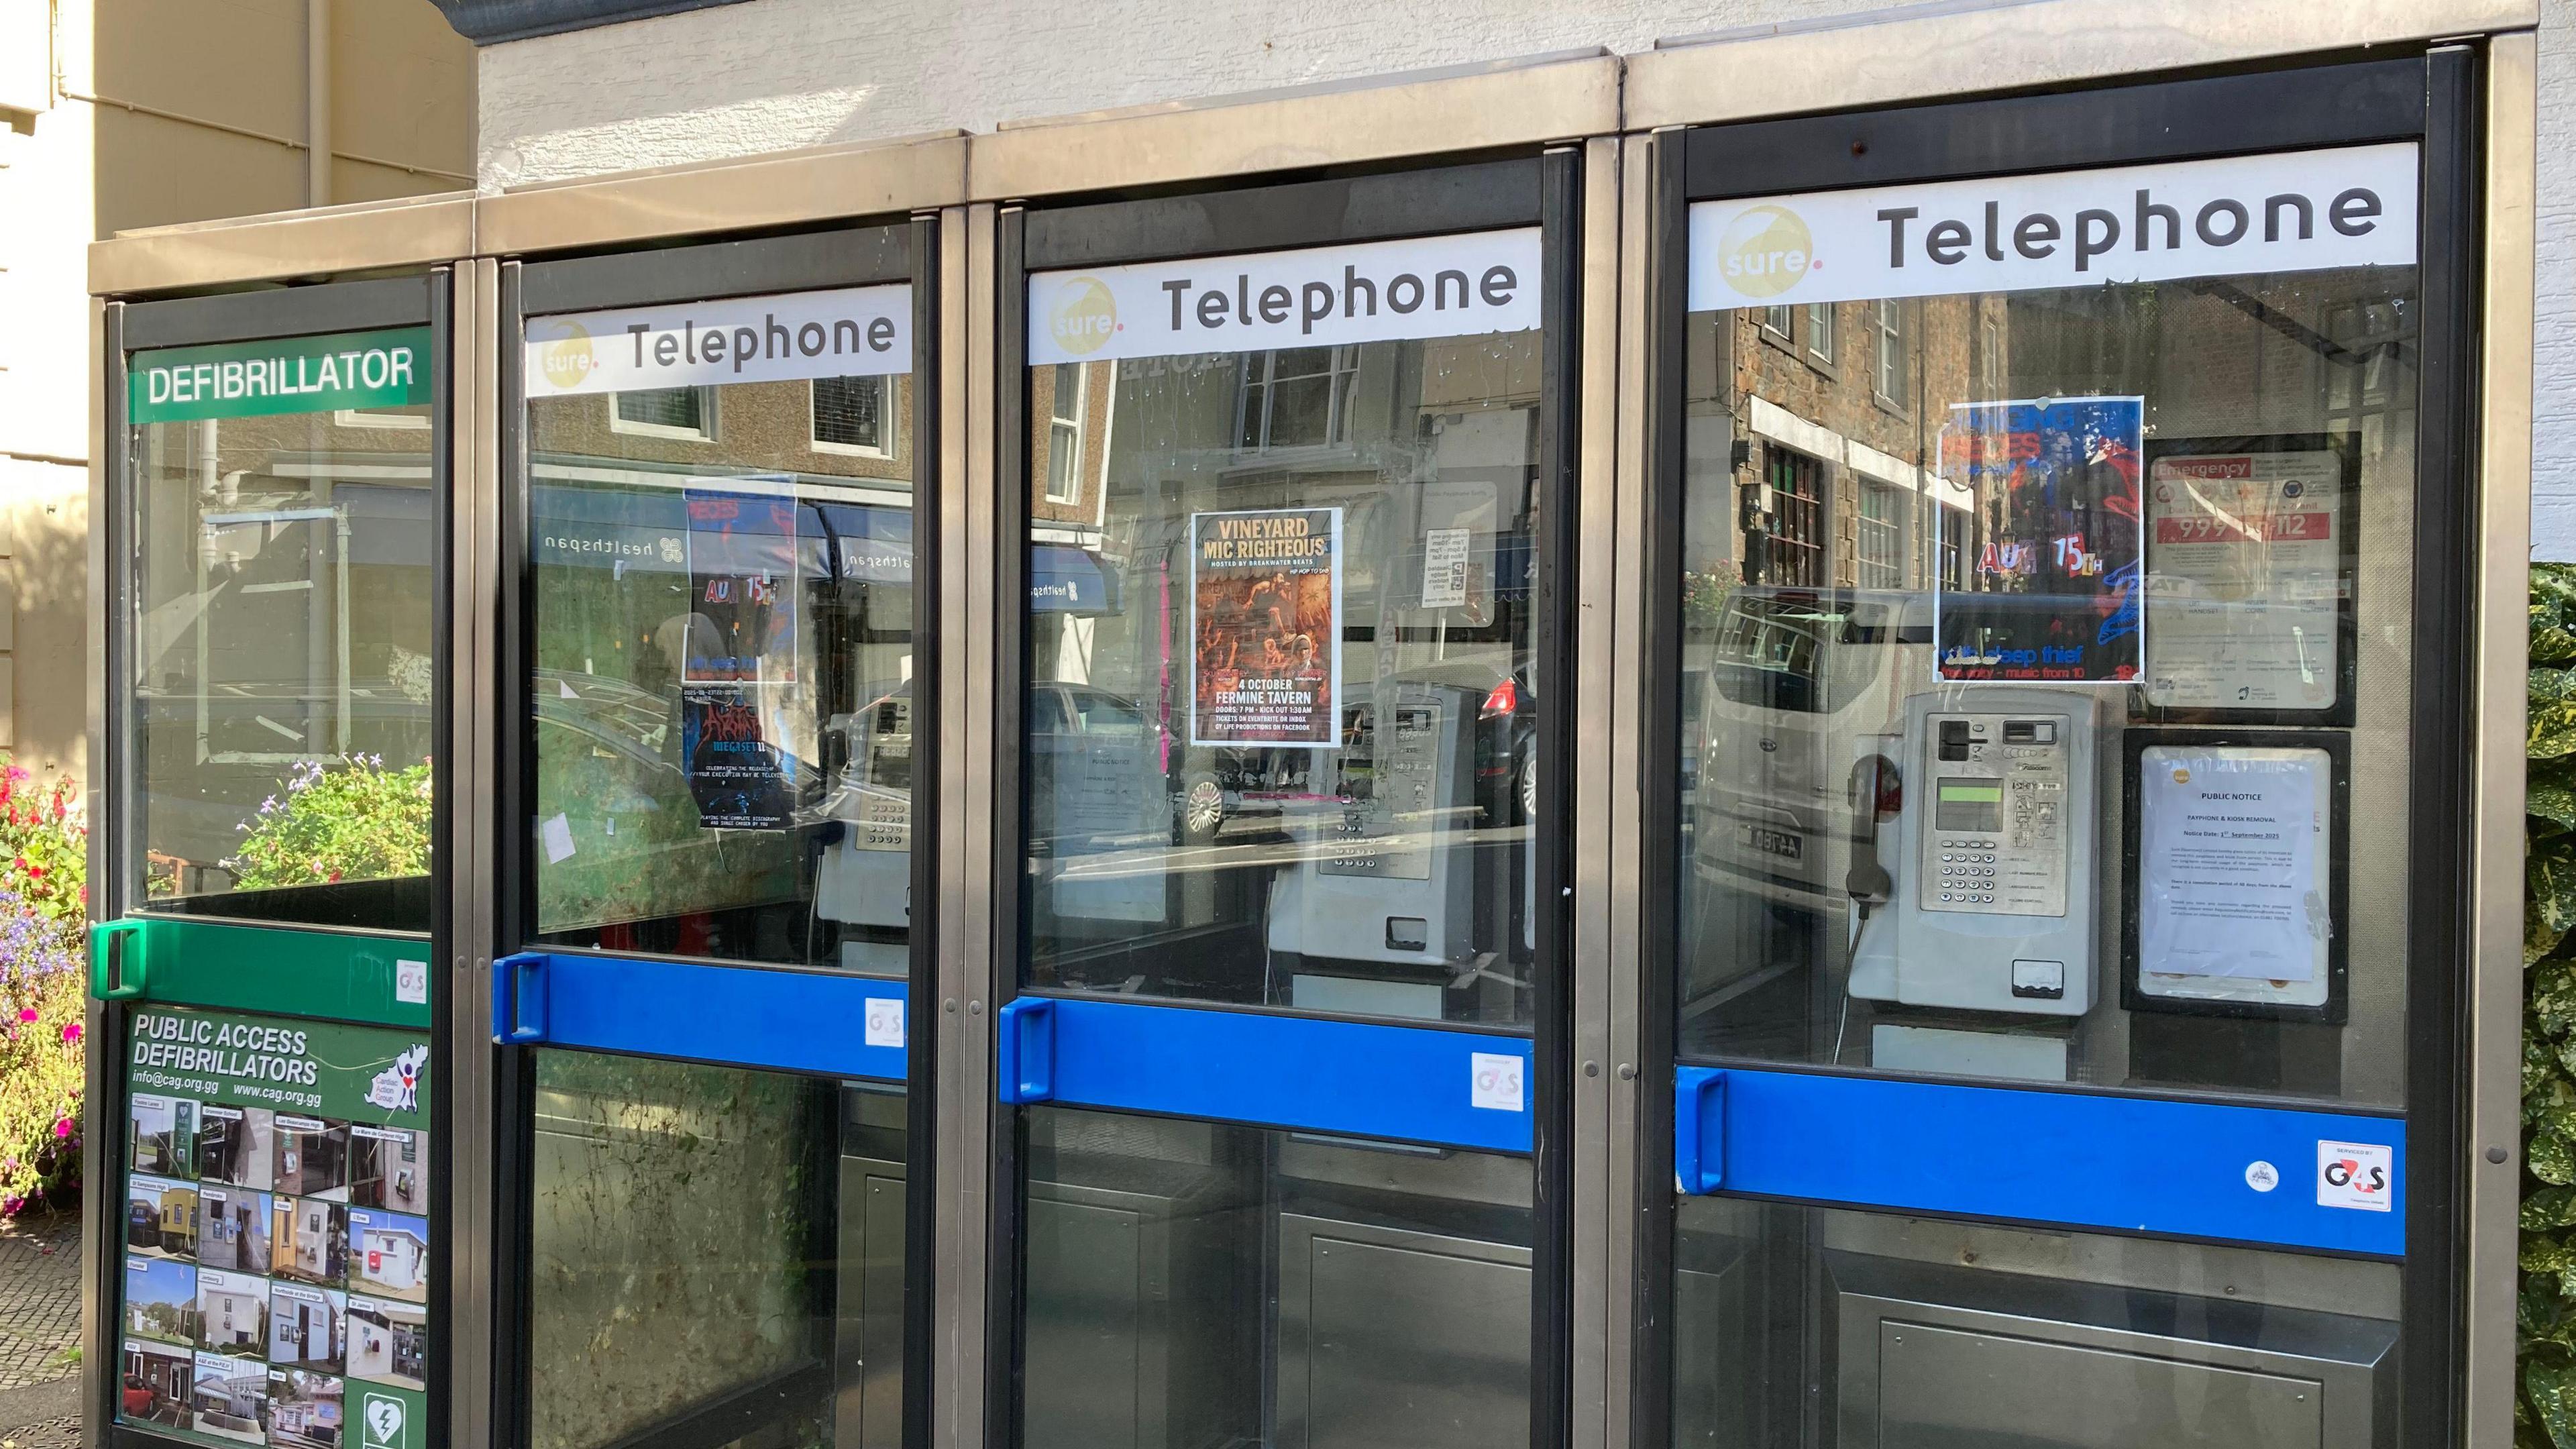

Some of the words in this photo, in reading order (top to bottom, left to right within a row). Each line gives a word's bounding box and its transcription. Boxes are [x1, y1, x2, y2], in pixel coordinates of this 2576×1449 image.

[1878, 188, 2383, 272] Telephone
[1162, 264, 1517, 335] Telephone
[627, 313, 896, 374] Telephone
[148, 347, 413, 404] DEFIBRILLATOR
[2159, 463, 2246, 478] Emergency
[1218, 517, 1309, 539] VINEYARD
[2179, 519, 2228, 538] 999
[2275, 515, 2306, 535] 112
[1204, 541, 1233, 559] MIC
[1237, 538, 1325, 558] RIGHTEOUS
[2041, 644, 2084, 663] thief
[2005, 667, 2039, 679] music
[2043, 667, 2071, 678] from
[2072, 667, 2084, 678] 10
[1238, 679, 1245, 690] 4
[1248, 679, 1293, 690] OCTOBER
[1216, 692, 1265, 704] FERMINE
[1267, 692, 1311, 704] TAVERN
[134, 1014, 211, 1044] PUBLIC
[215, 1023, 307, 1055] ACCESS
[134, 1041, 318, 1085] DEFIBRILLATORS
[133, 1070, 219, 1095] info@cag.org.gg
[234, 1083, 321, 1108] www.cag.org.gg
[376, 1077, 398, 1086] Cardiac
[376, 1086, 394, 1094] Action
[376, 1093, 393, 1103] Group
[2337, 1147, 2365, 1156] SERVICED
[307, 1293, 321, 1301] Bridge
[358, 1302, 371, 1310] James
